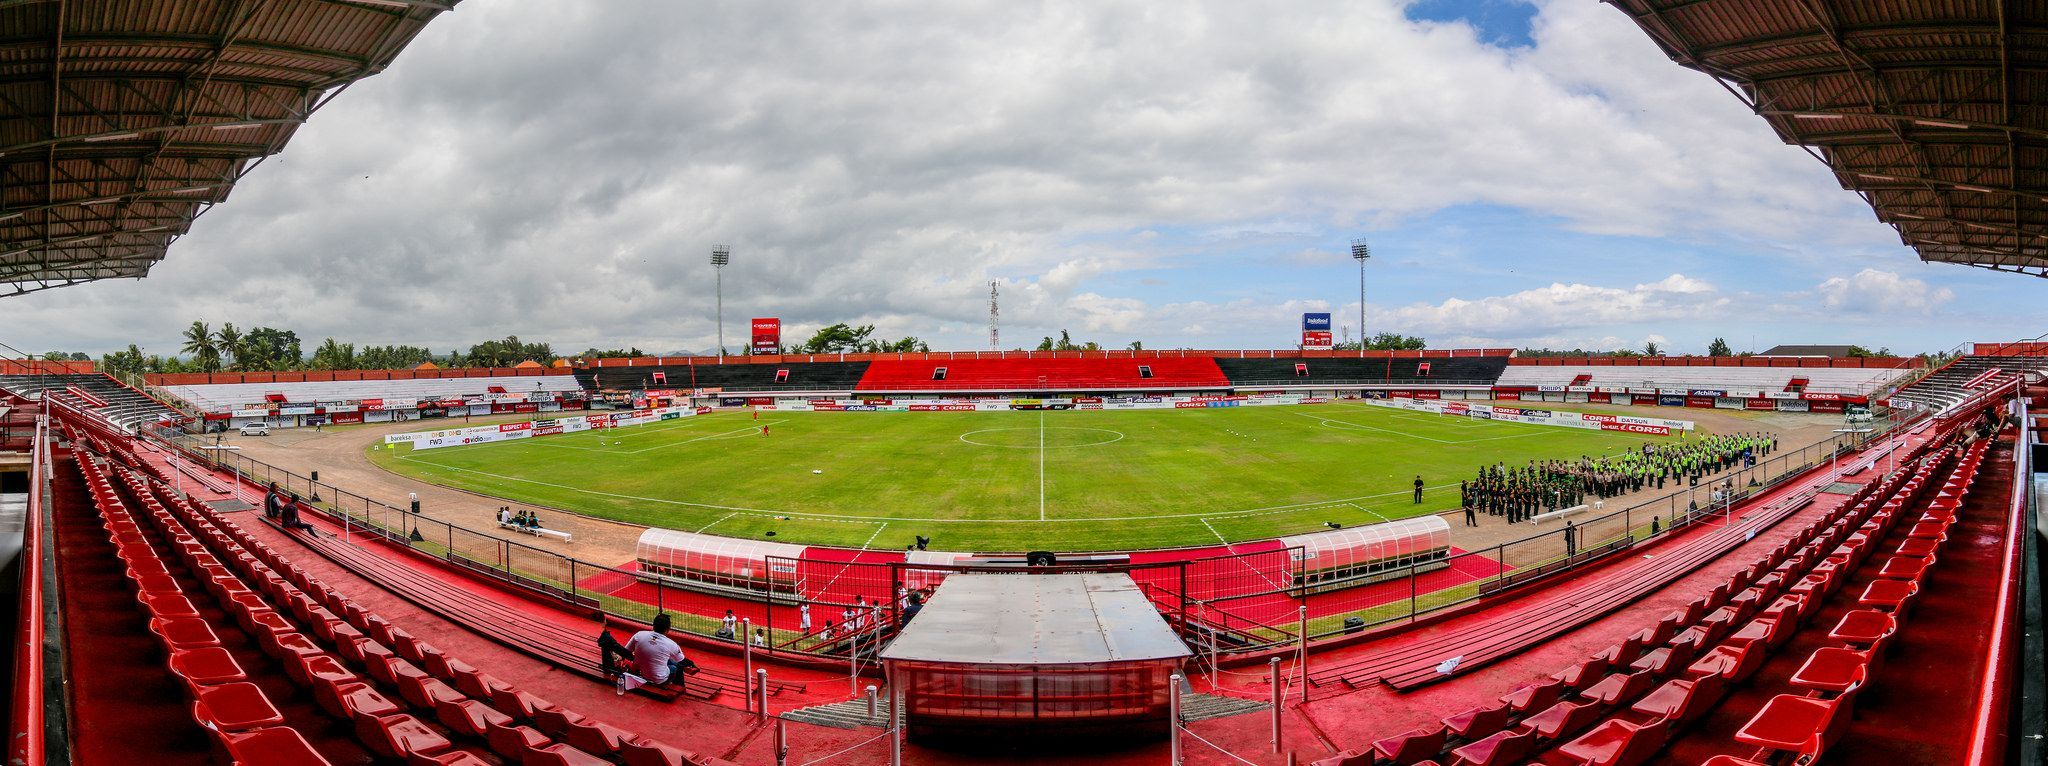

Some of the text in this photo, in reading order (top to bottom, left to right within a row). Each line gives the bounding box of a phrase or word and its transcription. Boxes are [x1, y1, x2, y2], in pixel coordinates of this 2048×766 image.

[1781, 401, 1808, 409] Indofood
[1522, 409, 1550, 417] Achilles
[1629, 425, 1668, 434] CORSA
[391, 434, 422, 442] bareksa.com
